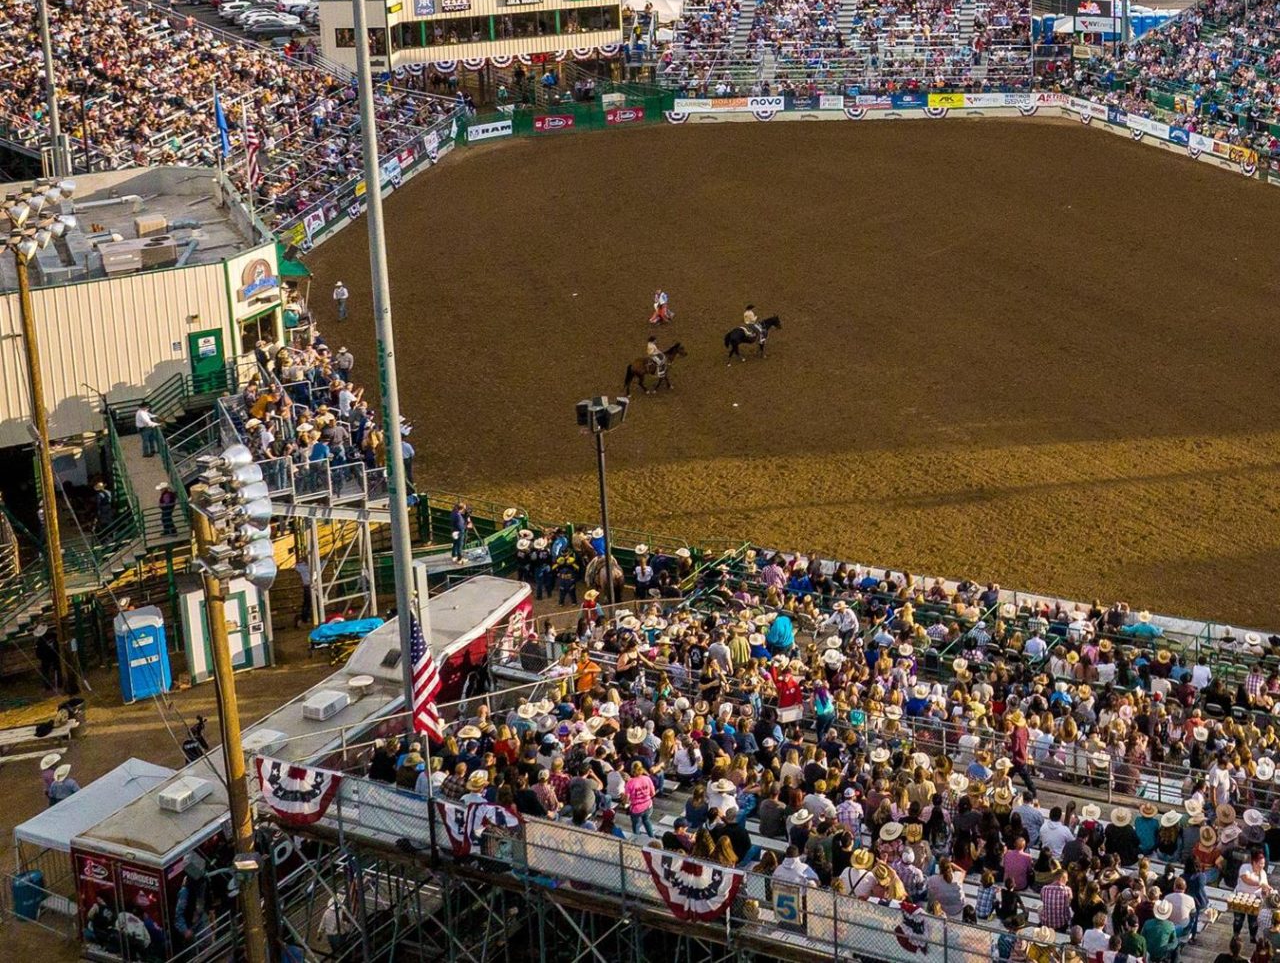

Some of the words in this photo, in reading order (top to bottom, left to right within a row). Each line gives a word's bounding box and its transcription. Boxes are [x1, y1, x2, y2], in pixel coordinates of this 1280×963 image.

[751, 98, 782, 106] novo
[481, 124, 512, 135] RAM
[776, 894, 797, 920] 5
